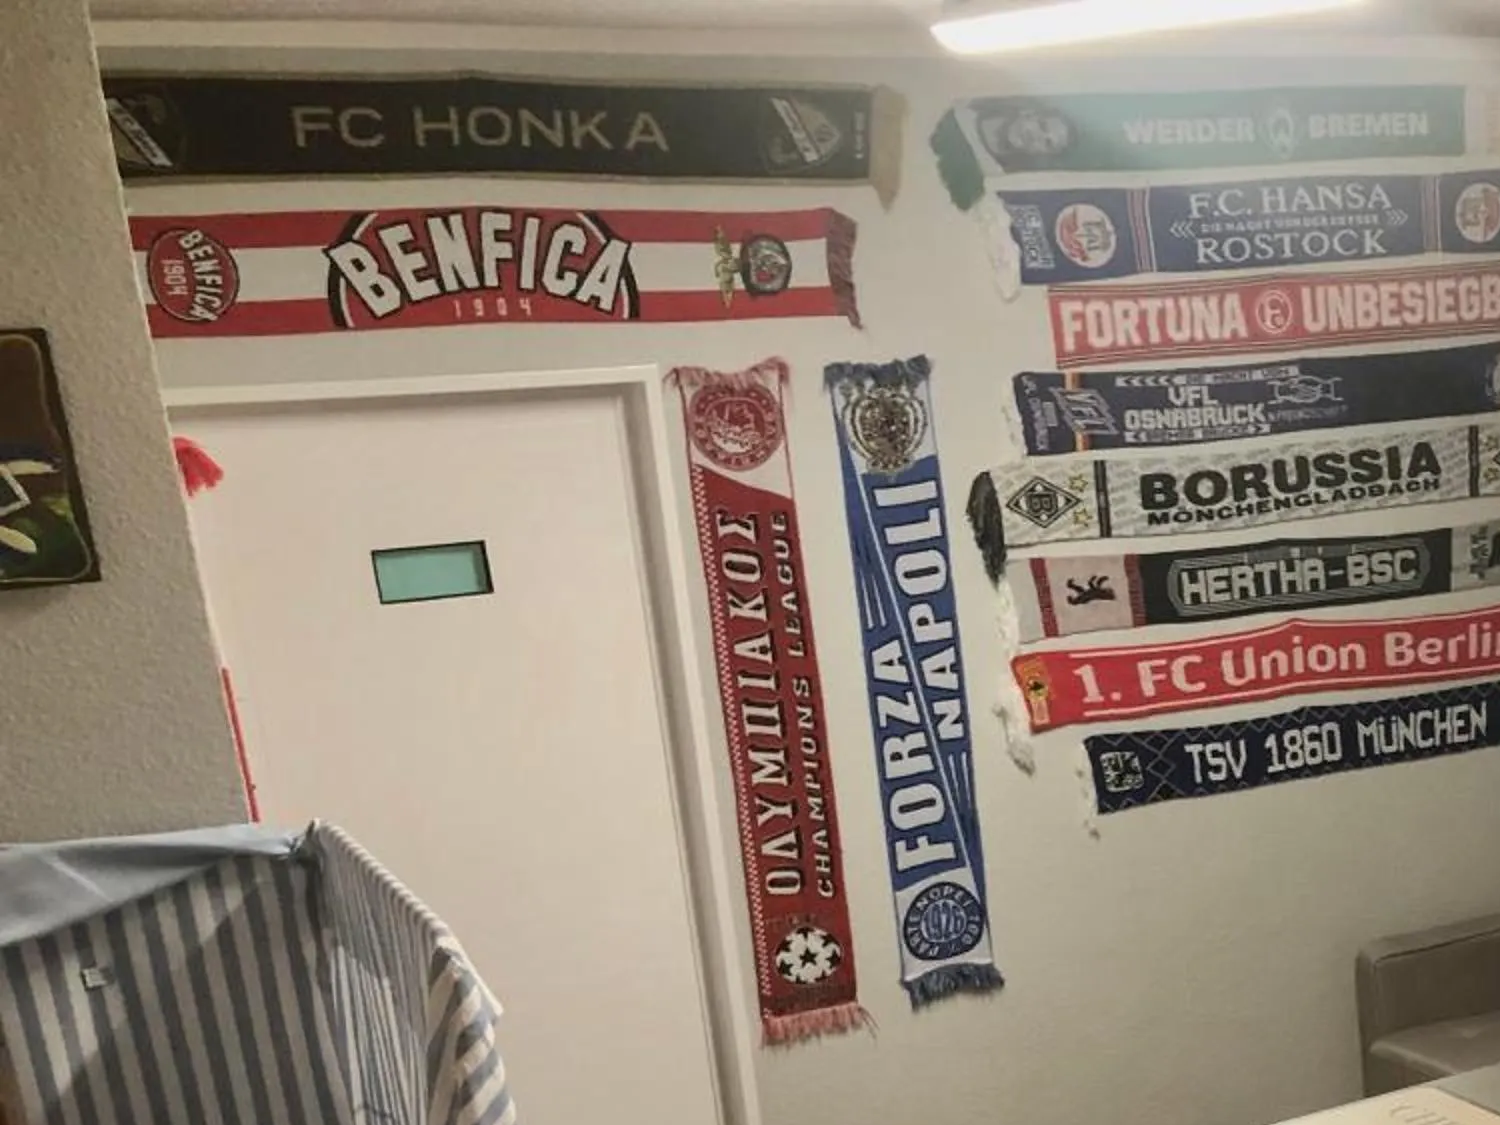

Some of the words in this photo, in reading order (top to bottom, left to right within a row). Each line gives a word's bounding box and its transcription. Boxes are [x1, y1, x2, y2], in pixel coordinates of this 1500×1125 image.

[291, 106, 384, 150] FC
[413, 102, 669, 153] HONKA
[1122, 116, 1256, 145] WERDER
[1309, 110, 1430, 140] BREMEN
[1187, 188, 1253, 220] F.C.
[1259, 182, 1393, 215] HANSA
[161, 259, 189, 295] 1904
[179, 229, 223, 321] BENFICA
[328, 210, 633, 320] BENFICA
[1195, 228, 1389, 265] ROSTOCK
[451, 296, 534, 321] 1904
[1060, 289, 1246, 352] FORTUNA
[1139, 440, 1444, 513] BORUSSIA
[1146, 475, 1442, 527] MÖNCHENGLADBACH
[771, 511, 806, 657] LEAGUE
[873, 480, 965, 741] NAPOLI
[1178, 547, 1420, 606] HERTHA-BSC
[1071, 662, 1122, 705] 1.
[1138, 653, 1206, 699] FC
[1222, 631, 1367, 687] Union
[871, 640, 958, 872] FORZA
[1184, 739, 1248, 786] TSV
[1263, 722, 1343, 776] 1860
[1356, 701, 1489, 760] MÜNCHEN
[792, 676, 835, 898] CHAMPIONS
